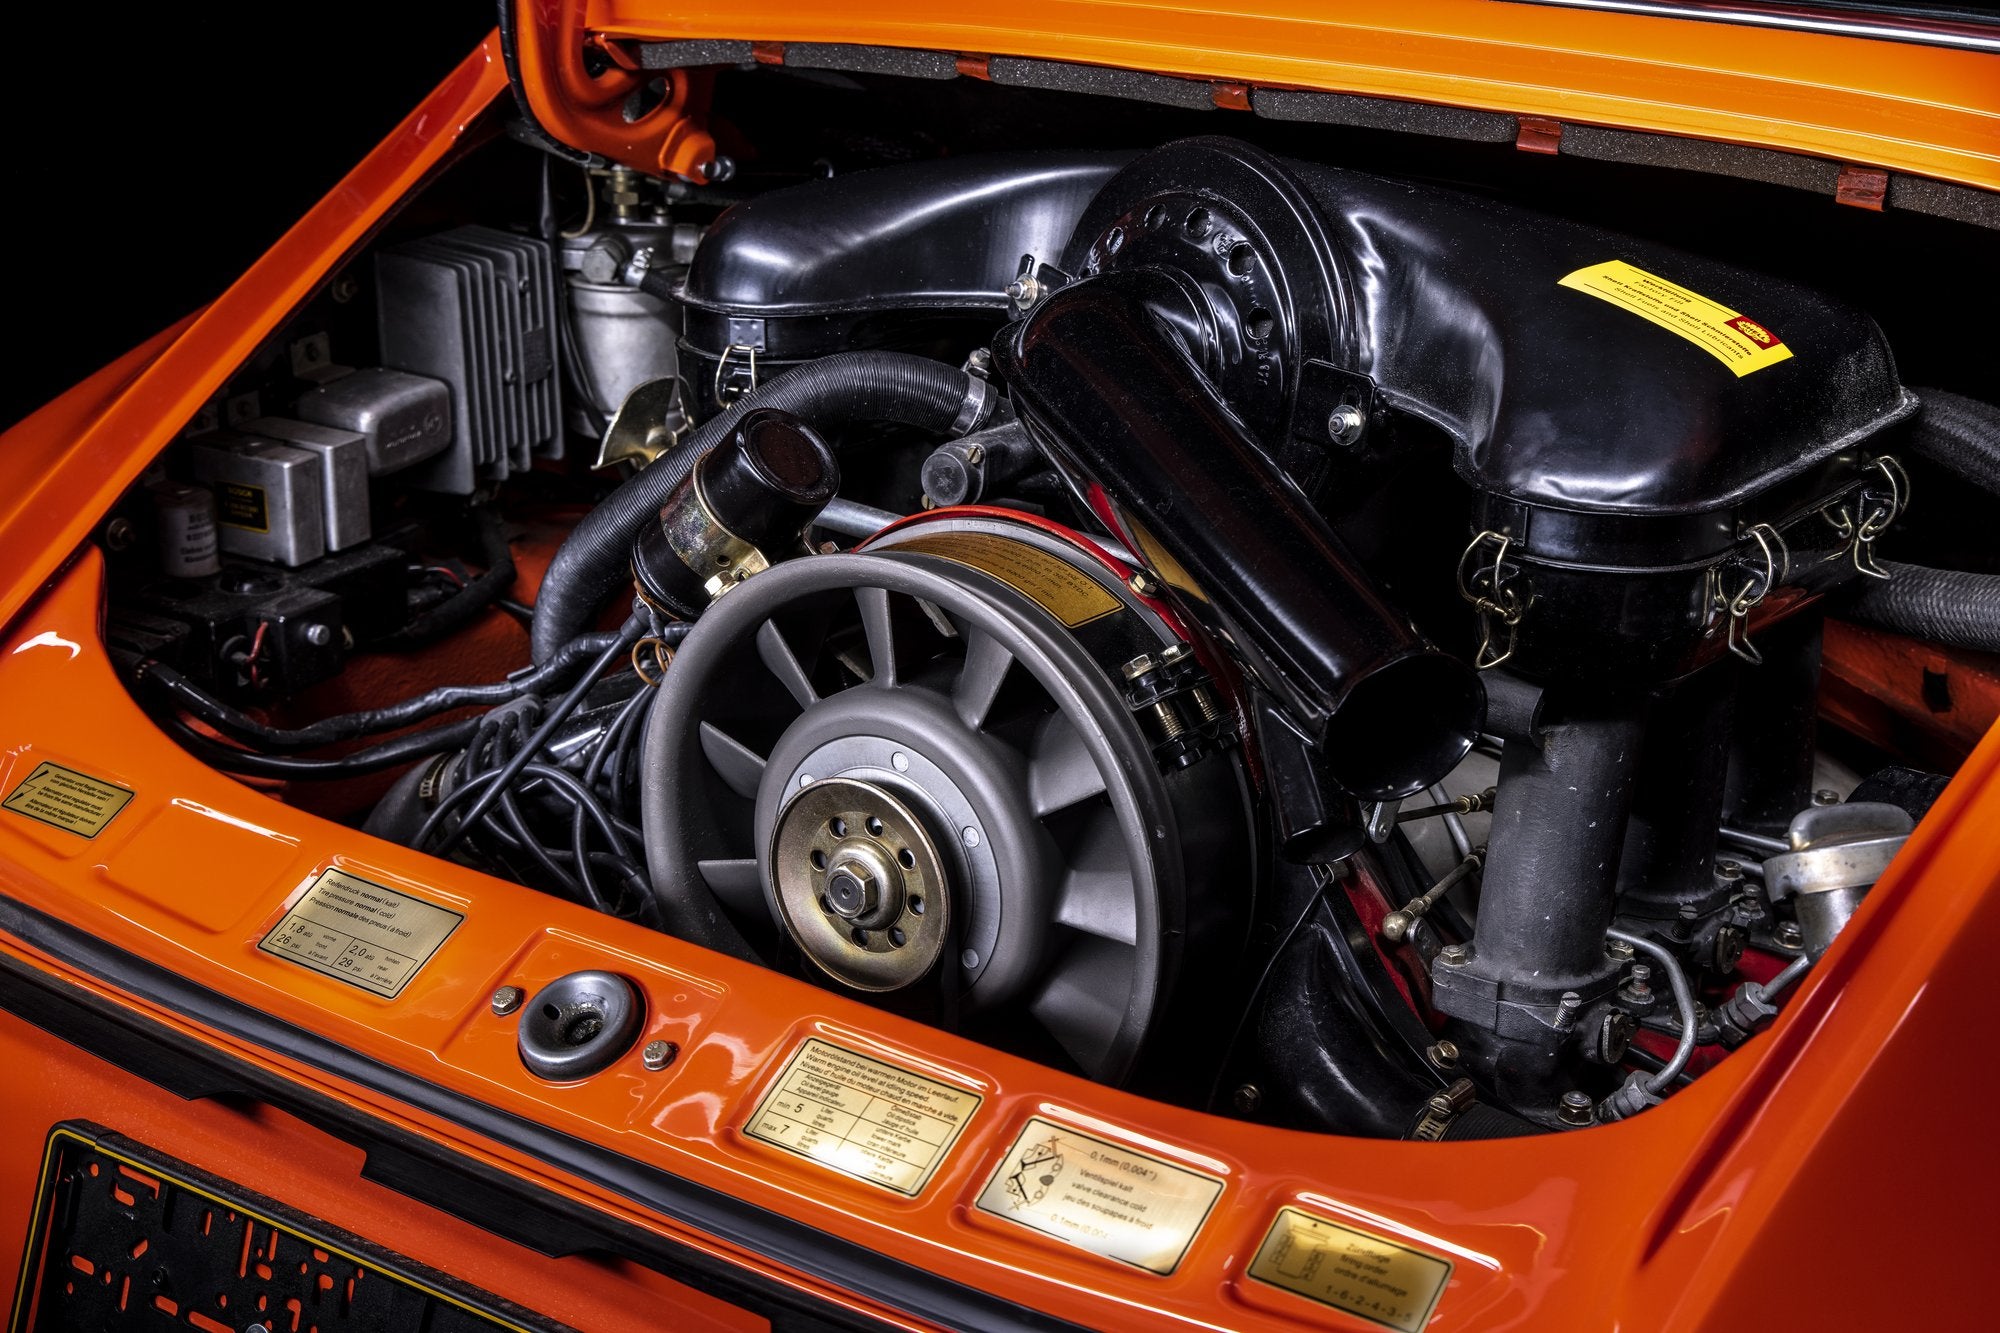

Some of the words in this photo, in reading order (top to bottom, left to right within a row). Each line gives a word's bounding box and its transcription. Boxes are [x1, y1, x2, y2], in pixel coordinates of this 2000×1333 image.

[1634, 281, 1666, 297] Factory
[1602, 275, 1623, 286] Shell
[1624, 284, 1662, 304] Kraftstoffe
[1664, 304, 1680, 312] und
[1680, 311, 1702, 322] Shell
[1702, 322, 1752, 356] Schmierstoffe
[1614, 288, 1636, 298] Shell
[1637, 298, 1659, 310] Fuels
[1660, 310, 1678, 318] and
[1678, 318, 1701, 330] Shell
[1702, 330, 1744, 359] Lubricants
[1742, 322, 1766, 340] SHELL
[326, 878, 359, 894] Reifendruck
[360, 892, 383, 902] normal
[318, 887, 330, 896] Tire
[327, 893, 354, 904] pressure
[354, 902, 377, 912] normal
[309, 896, 334, 910] Pression
[333, 907, 358, 918] normale
[368, 919, 387, 929] pneus
[289, 922, 305, 933] 1,8
[276, 933, 291, 944] 26
[348, 945, 366, 956] 2,0
[338, 957, 353, 967] 29
[384, 956, 400, 964] hinten
[806, 1053, 826, 1064] Warm
[826, 1062, 850, 1073] engine
[860, 1073, 878, 1082] level
[886, 1083, 905, 1094] idling
[811, 1046, 856, 1066] Motorölstand
[867, 1068, 895, 1080] warmen
[896, 1076, 917, 1087] Motor
[800, 1060, 823, 1073] Niveau
[830, 1071, 846, 1081] huile
[856, 1081, 880, 1092] moteur
[880, 1090, 901, 1100] chaud
[911, 1101, 936, 1113] marche
[821, 1088, 838, 1097] gauge
[794, 1103, 804, 1112] 5
[816, 1114, 833, 1122] quarts
[894, 1115, 915, 1125] dipstick
[761, 1122, 776, 1130] max
[780, 1124, 789, 1133] 7
[875, 1128, 893, 1136] untere
[895, 1134, 910, 1142] Kerbe
[801, 1135, 817, 1144] quarts
[871, 1133, 886, 1141] lower
[1080, 1169, 1118, 1186] Ventilspiel
[1118, 1183, 1132, 1191] kalt
[1072, 1183, 1091, 1192] valve
[1092, 1189, 1128, 1205] clearance
[1129, 1203, 1146, 1212] cold
[1076, 1198, 1089, 1206] des
[1092, 1204, 1127, 1220] soupapes
[1341, 1255, 1362, 1268] firing
[1364, 1264, 1387, 1274] order
[1334, 1268, 1357, 1278] ordre
